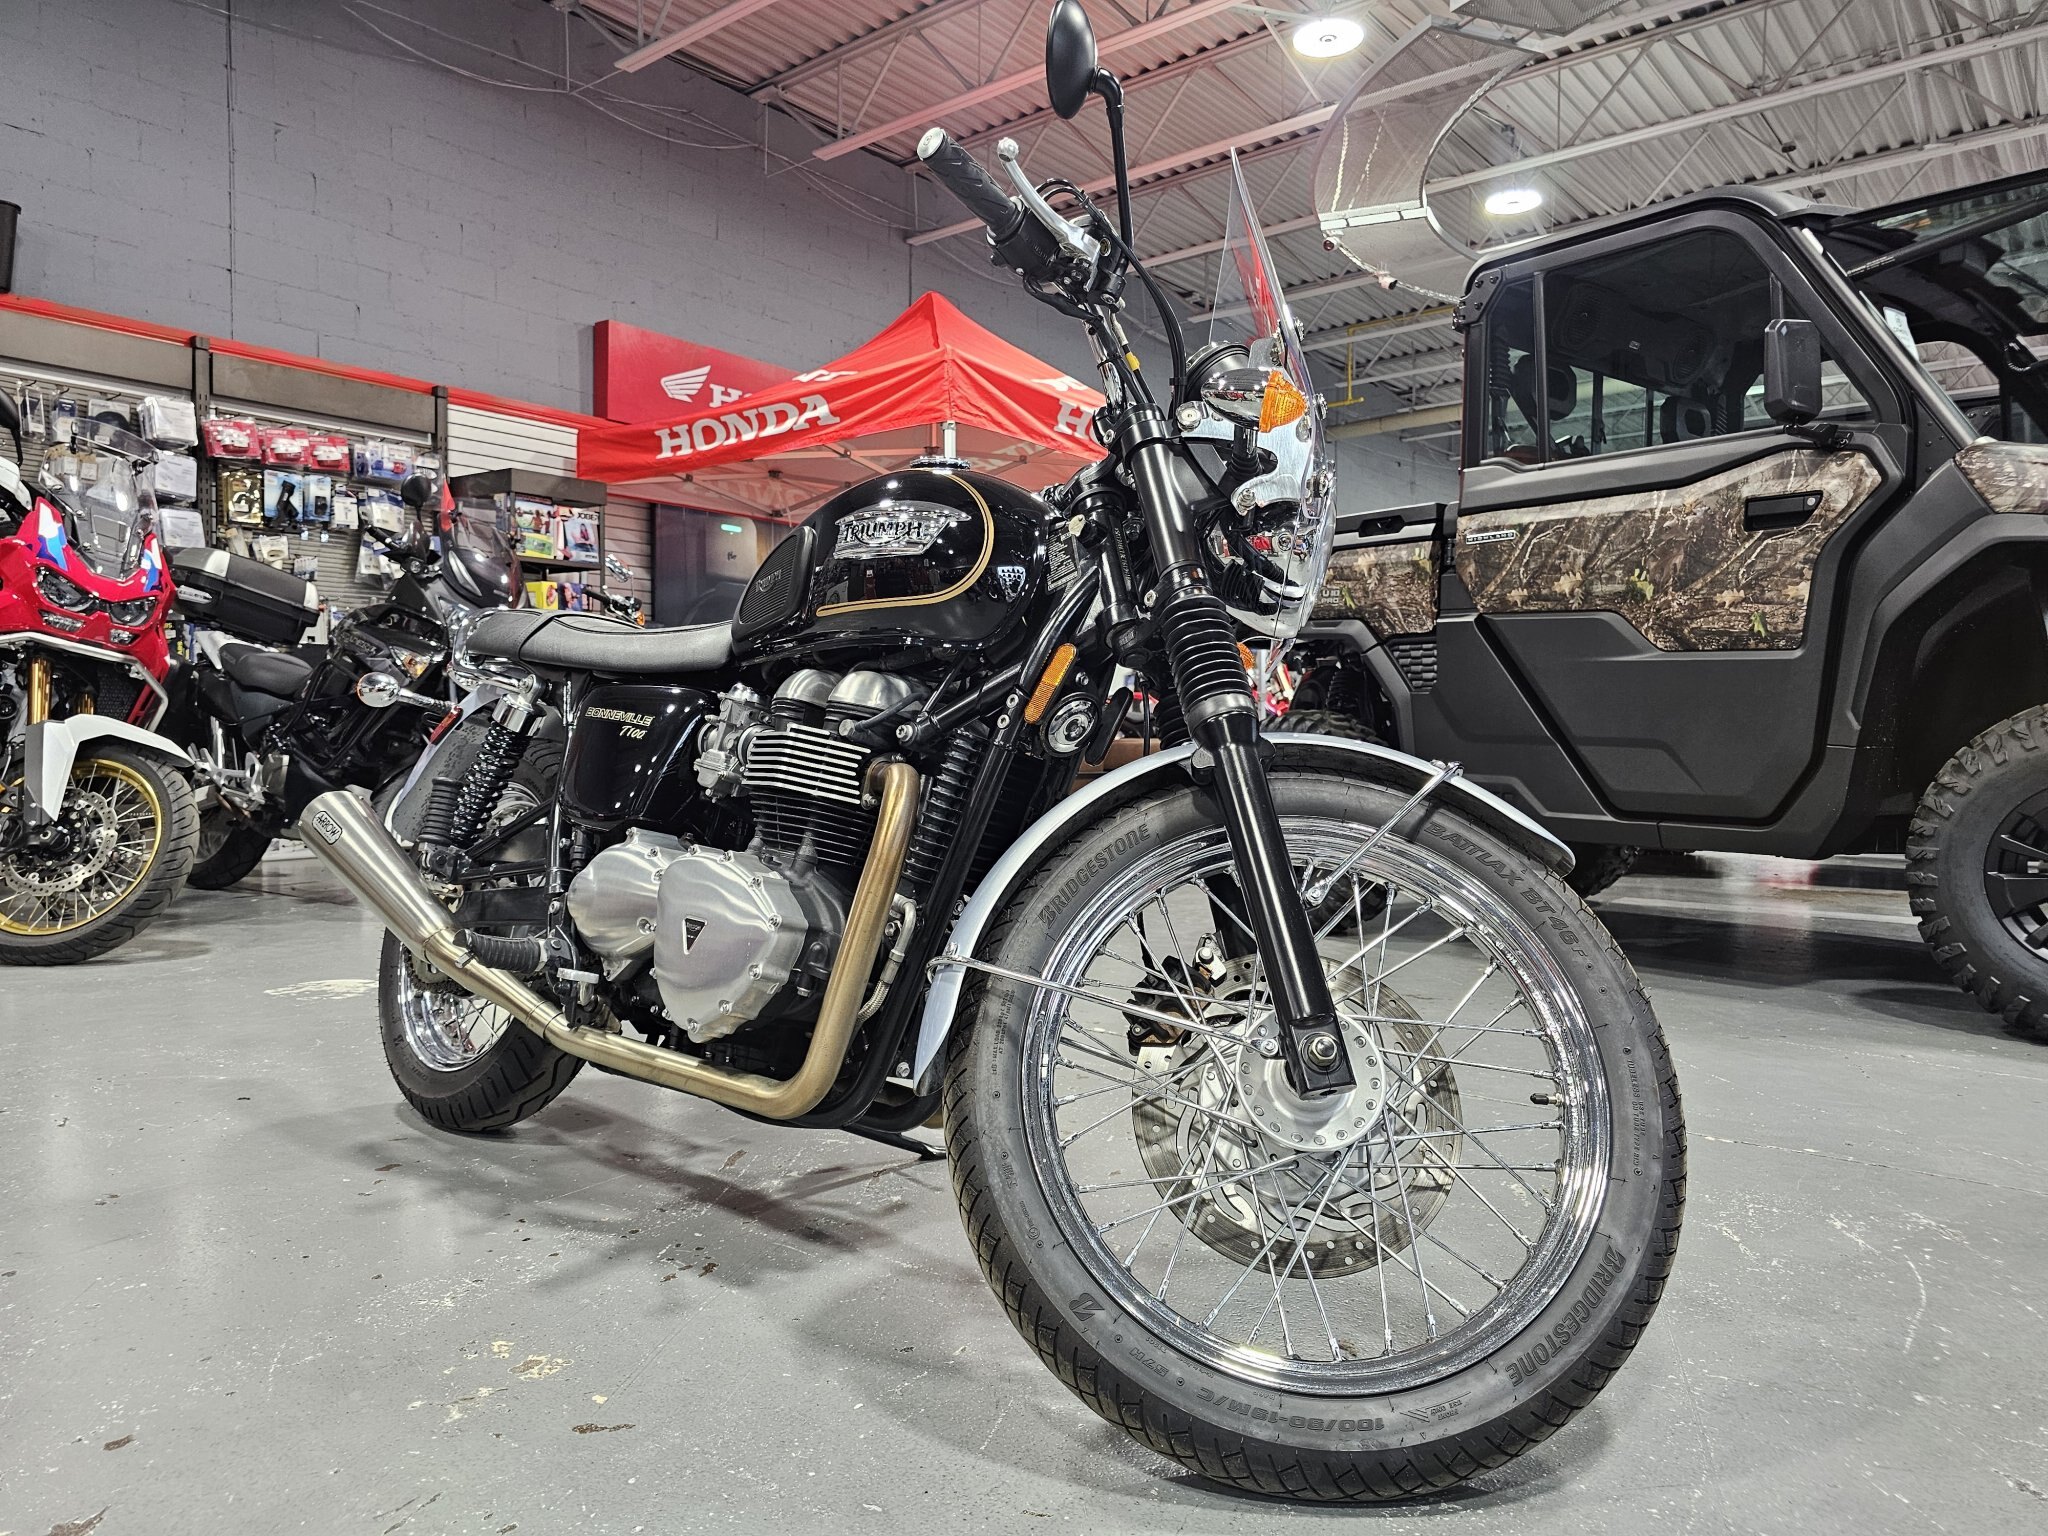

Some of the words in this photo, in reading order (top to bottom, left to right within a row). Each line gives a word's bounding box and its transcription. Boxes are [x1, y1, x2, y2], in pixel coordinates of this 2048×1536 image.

[709, 383, 752, 408] H
[655, 394, 841, 459] HONDA
[1054, 400, 1107, 448] H
[843, 521, 922, 545] TRIUMPH
[585, 706, 655, 727] BONNEVILLE
[619, 725, 648, 739] T100
[316, 813, 340, 838] ARROW
[1423, 822, 1524, 887] BATTLAX
[1039, 823, 1151, 930] BRIDGESTONE
[1505, 1243, 1627, 1387] BRIDGESTONE
[1129, 1347, 1169, 1378] 57H
